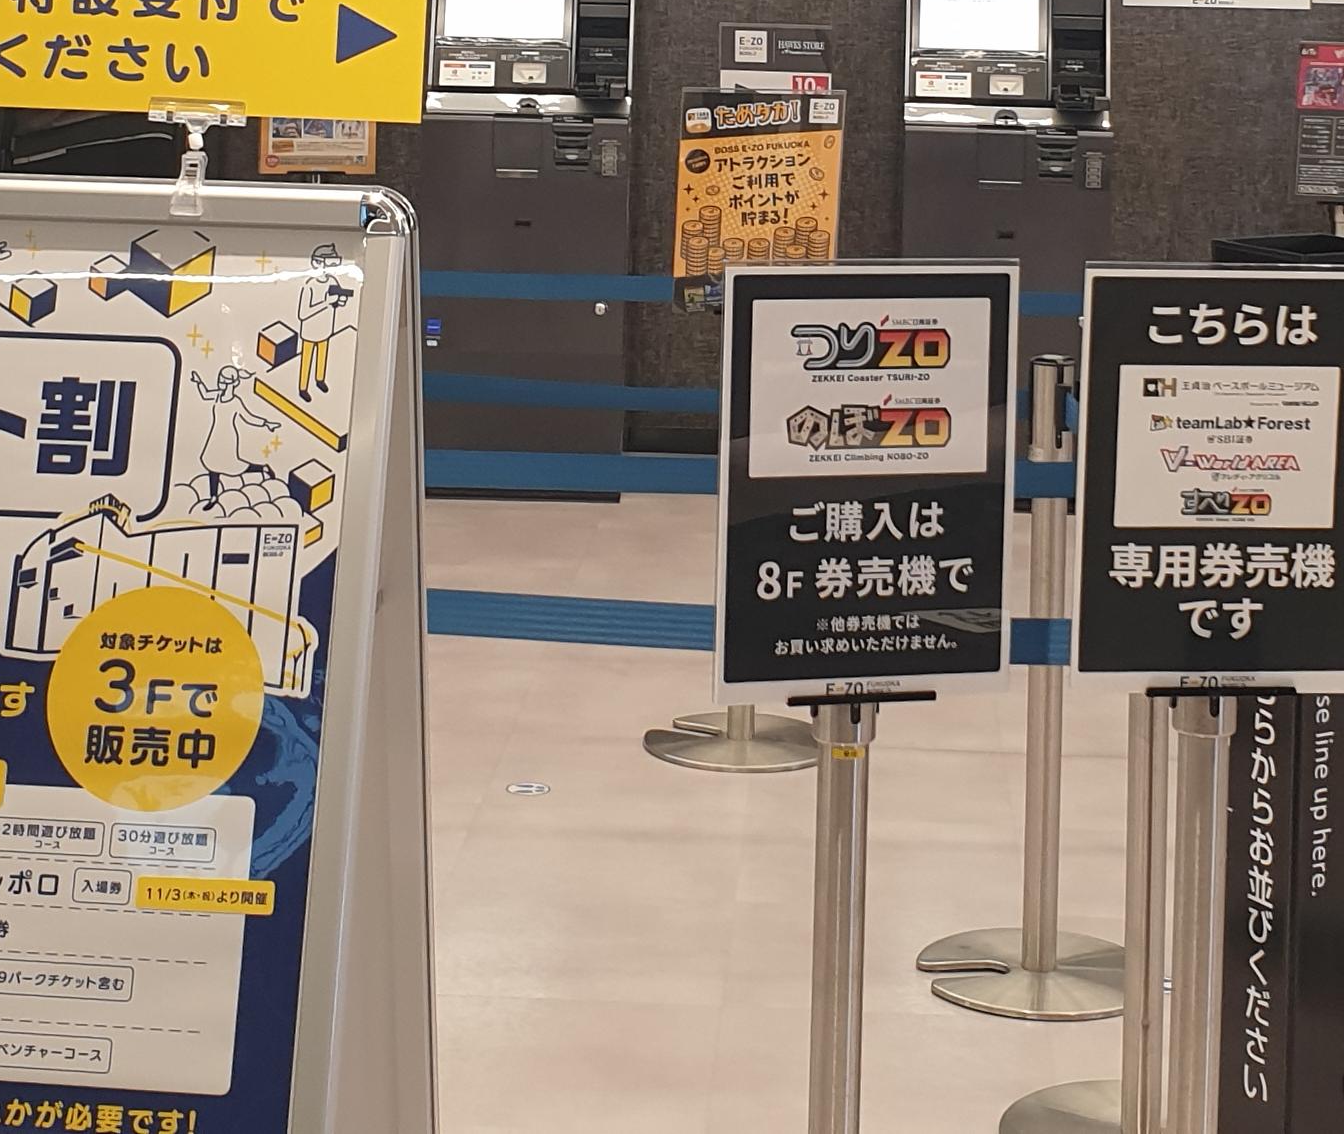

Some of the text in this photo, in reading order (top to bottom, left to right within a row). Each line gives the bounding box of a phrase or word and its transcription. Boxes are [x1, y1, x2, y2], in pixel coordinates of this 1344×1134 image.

[714, 154, 810, 172] アトラクション
[733, 173, 794, 190] ご利用で
[729, 190, 799, 210] ポイントが
[1148, 304, 1318, 345] こちらは
[848, 374, 883, 382] Coaster
[809, 454, 841, 462] ZEKKEI
[844, 453, 884, 462] Climbing
[789, 501, 944, 542] ご購入は
[756, 555, 974, 599] 8F 券売機で
[1109, 543, 1335, 588] 専用券売機
[1179, 598, 1263, 639] です
[100, 632, 223, 655] 対象チケットは
[775, 634, 957, 656] お買い求めいただけません。
[95, 659, 219, 716] 3Fで
[85, 727, 217, 769] 販売中
[1314, 731, 1335, 780] line
[1309, 787, 1328, 822] up
[2, 823, 96, 839] 2時間遊び放題
[118, 829, 208, 846] 30分遊び放題
[1311, 828, 1332, 897] here.
